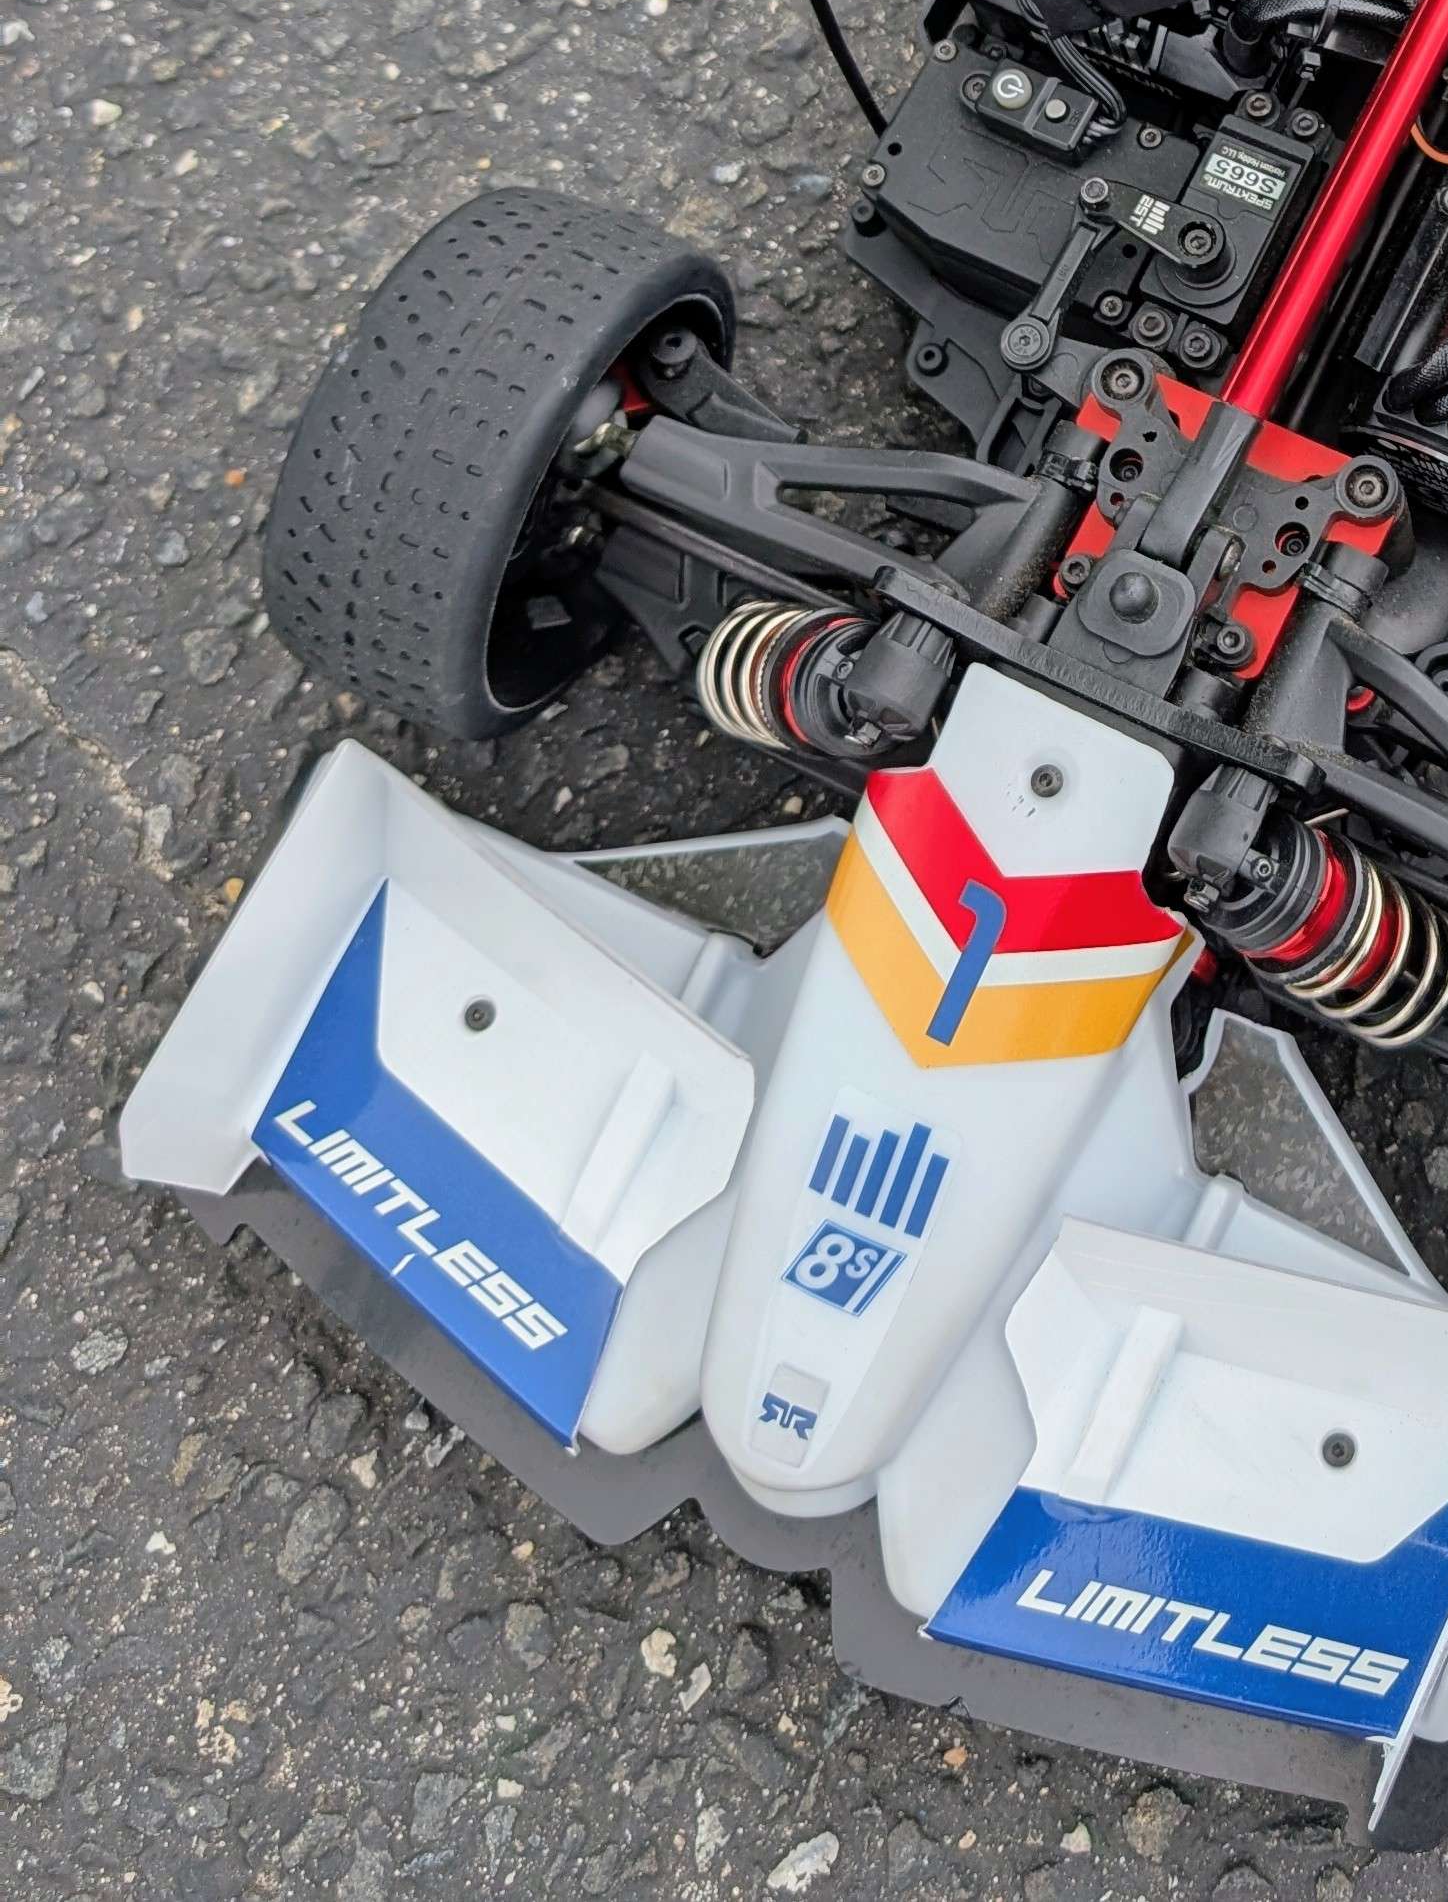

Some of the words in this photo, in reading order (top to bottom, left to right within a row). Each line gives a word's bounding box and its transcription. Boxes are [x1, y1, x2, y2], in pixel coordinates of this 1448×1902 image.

[1221, 145, 1237, 158] LLC
[1206, 176, 1274, 210] SPEKTRUM
[1213, 158, 1278, 195] S665
[273, 1099, 569, 1353] LIMITLESS
[1015, 1569, 1410, 1697] LIMITLESS
